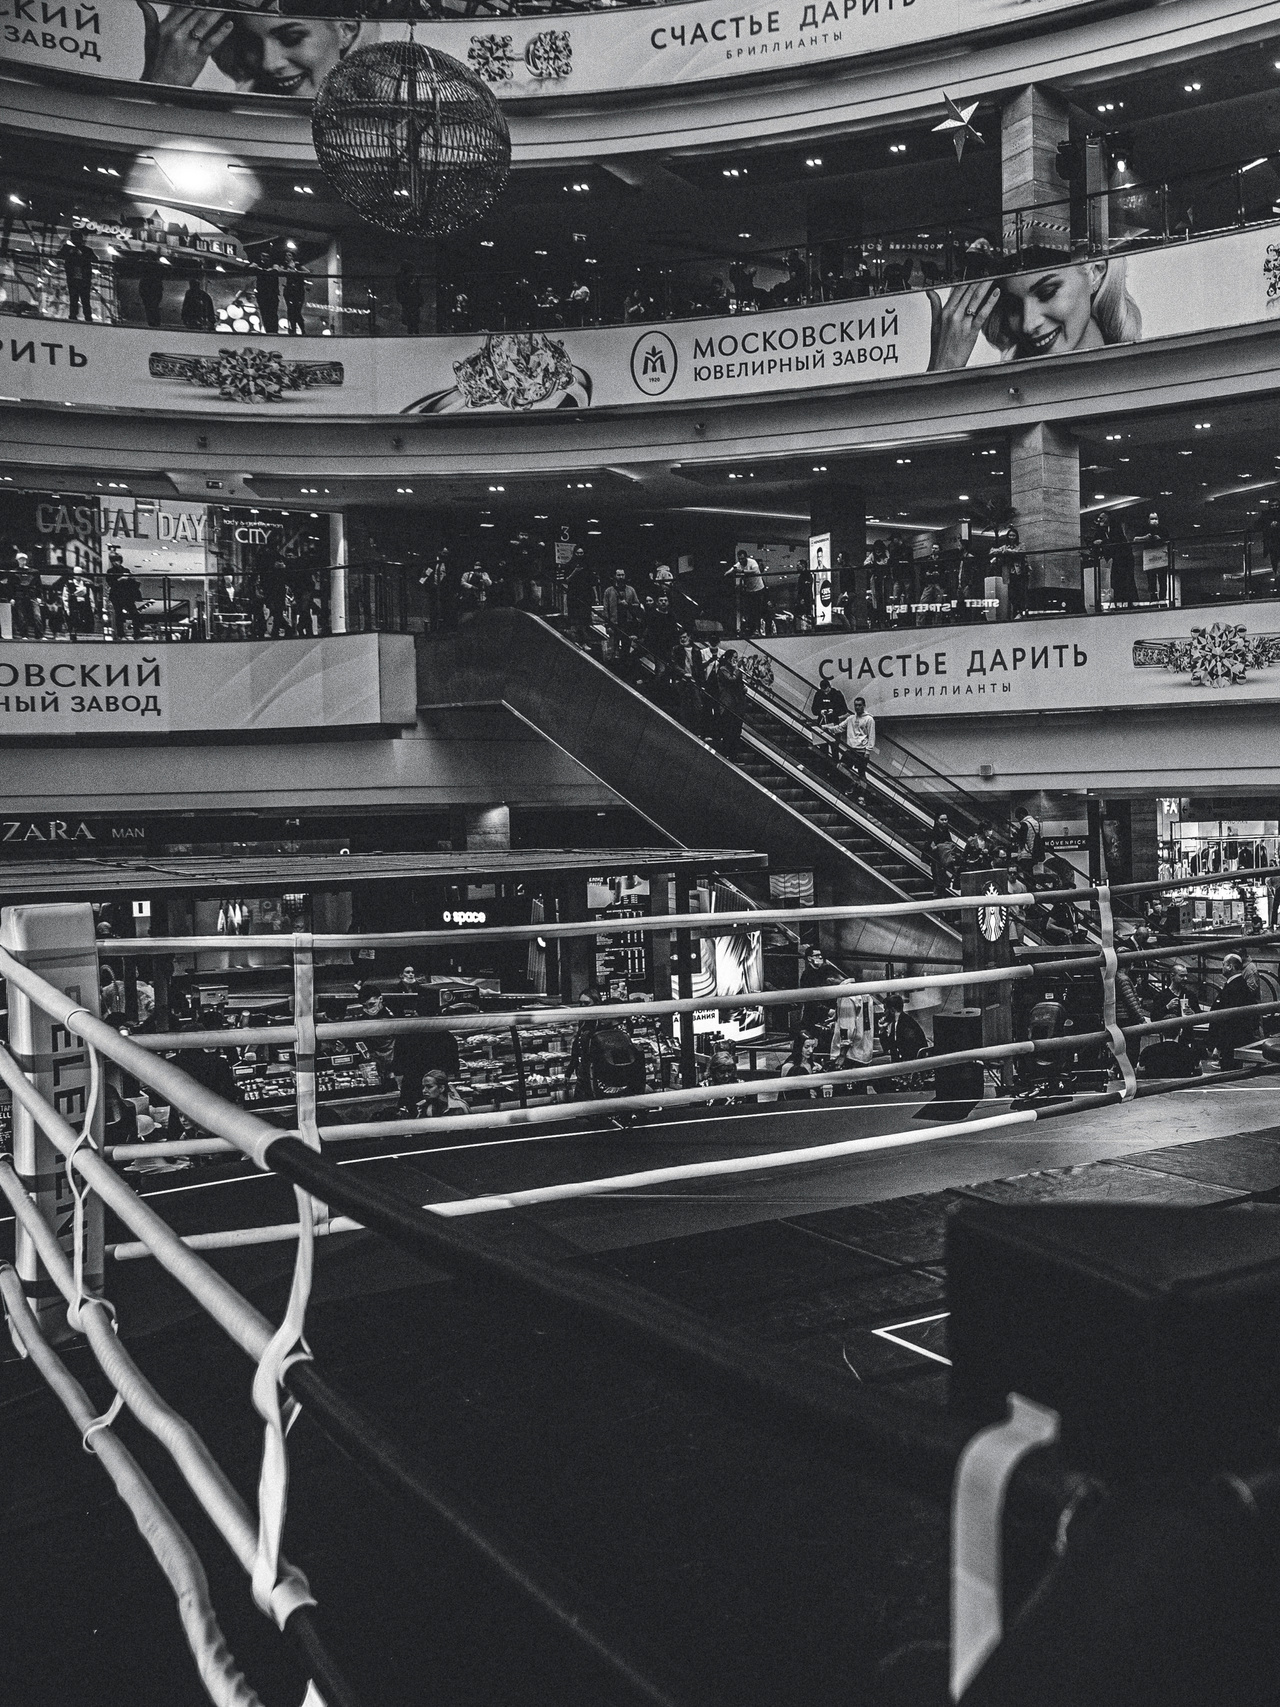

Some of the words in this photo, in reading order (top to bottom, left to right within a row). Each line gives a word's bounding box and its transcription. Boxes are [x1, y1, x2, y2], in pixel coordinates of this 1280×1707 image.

[0, 0, 100, 33] КИЙ
[650, 11, 780, 50] СЧАСТЬЕ
[4, 25, 101, 62] ЗАВОД
[726, 31, 842, 59] БРИЛЛИАНТЫ
[693, 308, 898, 359] МОСКОВСКИЙ
[0, 339, 87, 367] ИТЬ
[693, 350, 825, 381] ЮВЕЛИРНЫЙ
[832, 344, 899, 366] ЗАВОД
[36, 502, 150, 539] CASUAL
[156, 511, 208, 542] DAY
[235, 527, 272, 541] CITY
[561, 526, 570, 541] 3
[819, 653, 947, 681] СЧАСТЬЕ
[967, 644, 1088, 677] ДАРИТЬ
[893, 683, 1012, 698] БРИЛЛИАНТЫ
[71, 695, 162, 717] ЗАВОД
[3, 820, 96, 842] ZARA
[112, 828, 145, 839] MAN
[452, 911, 486, 925] space
